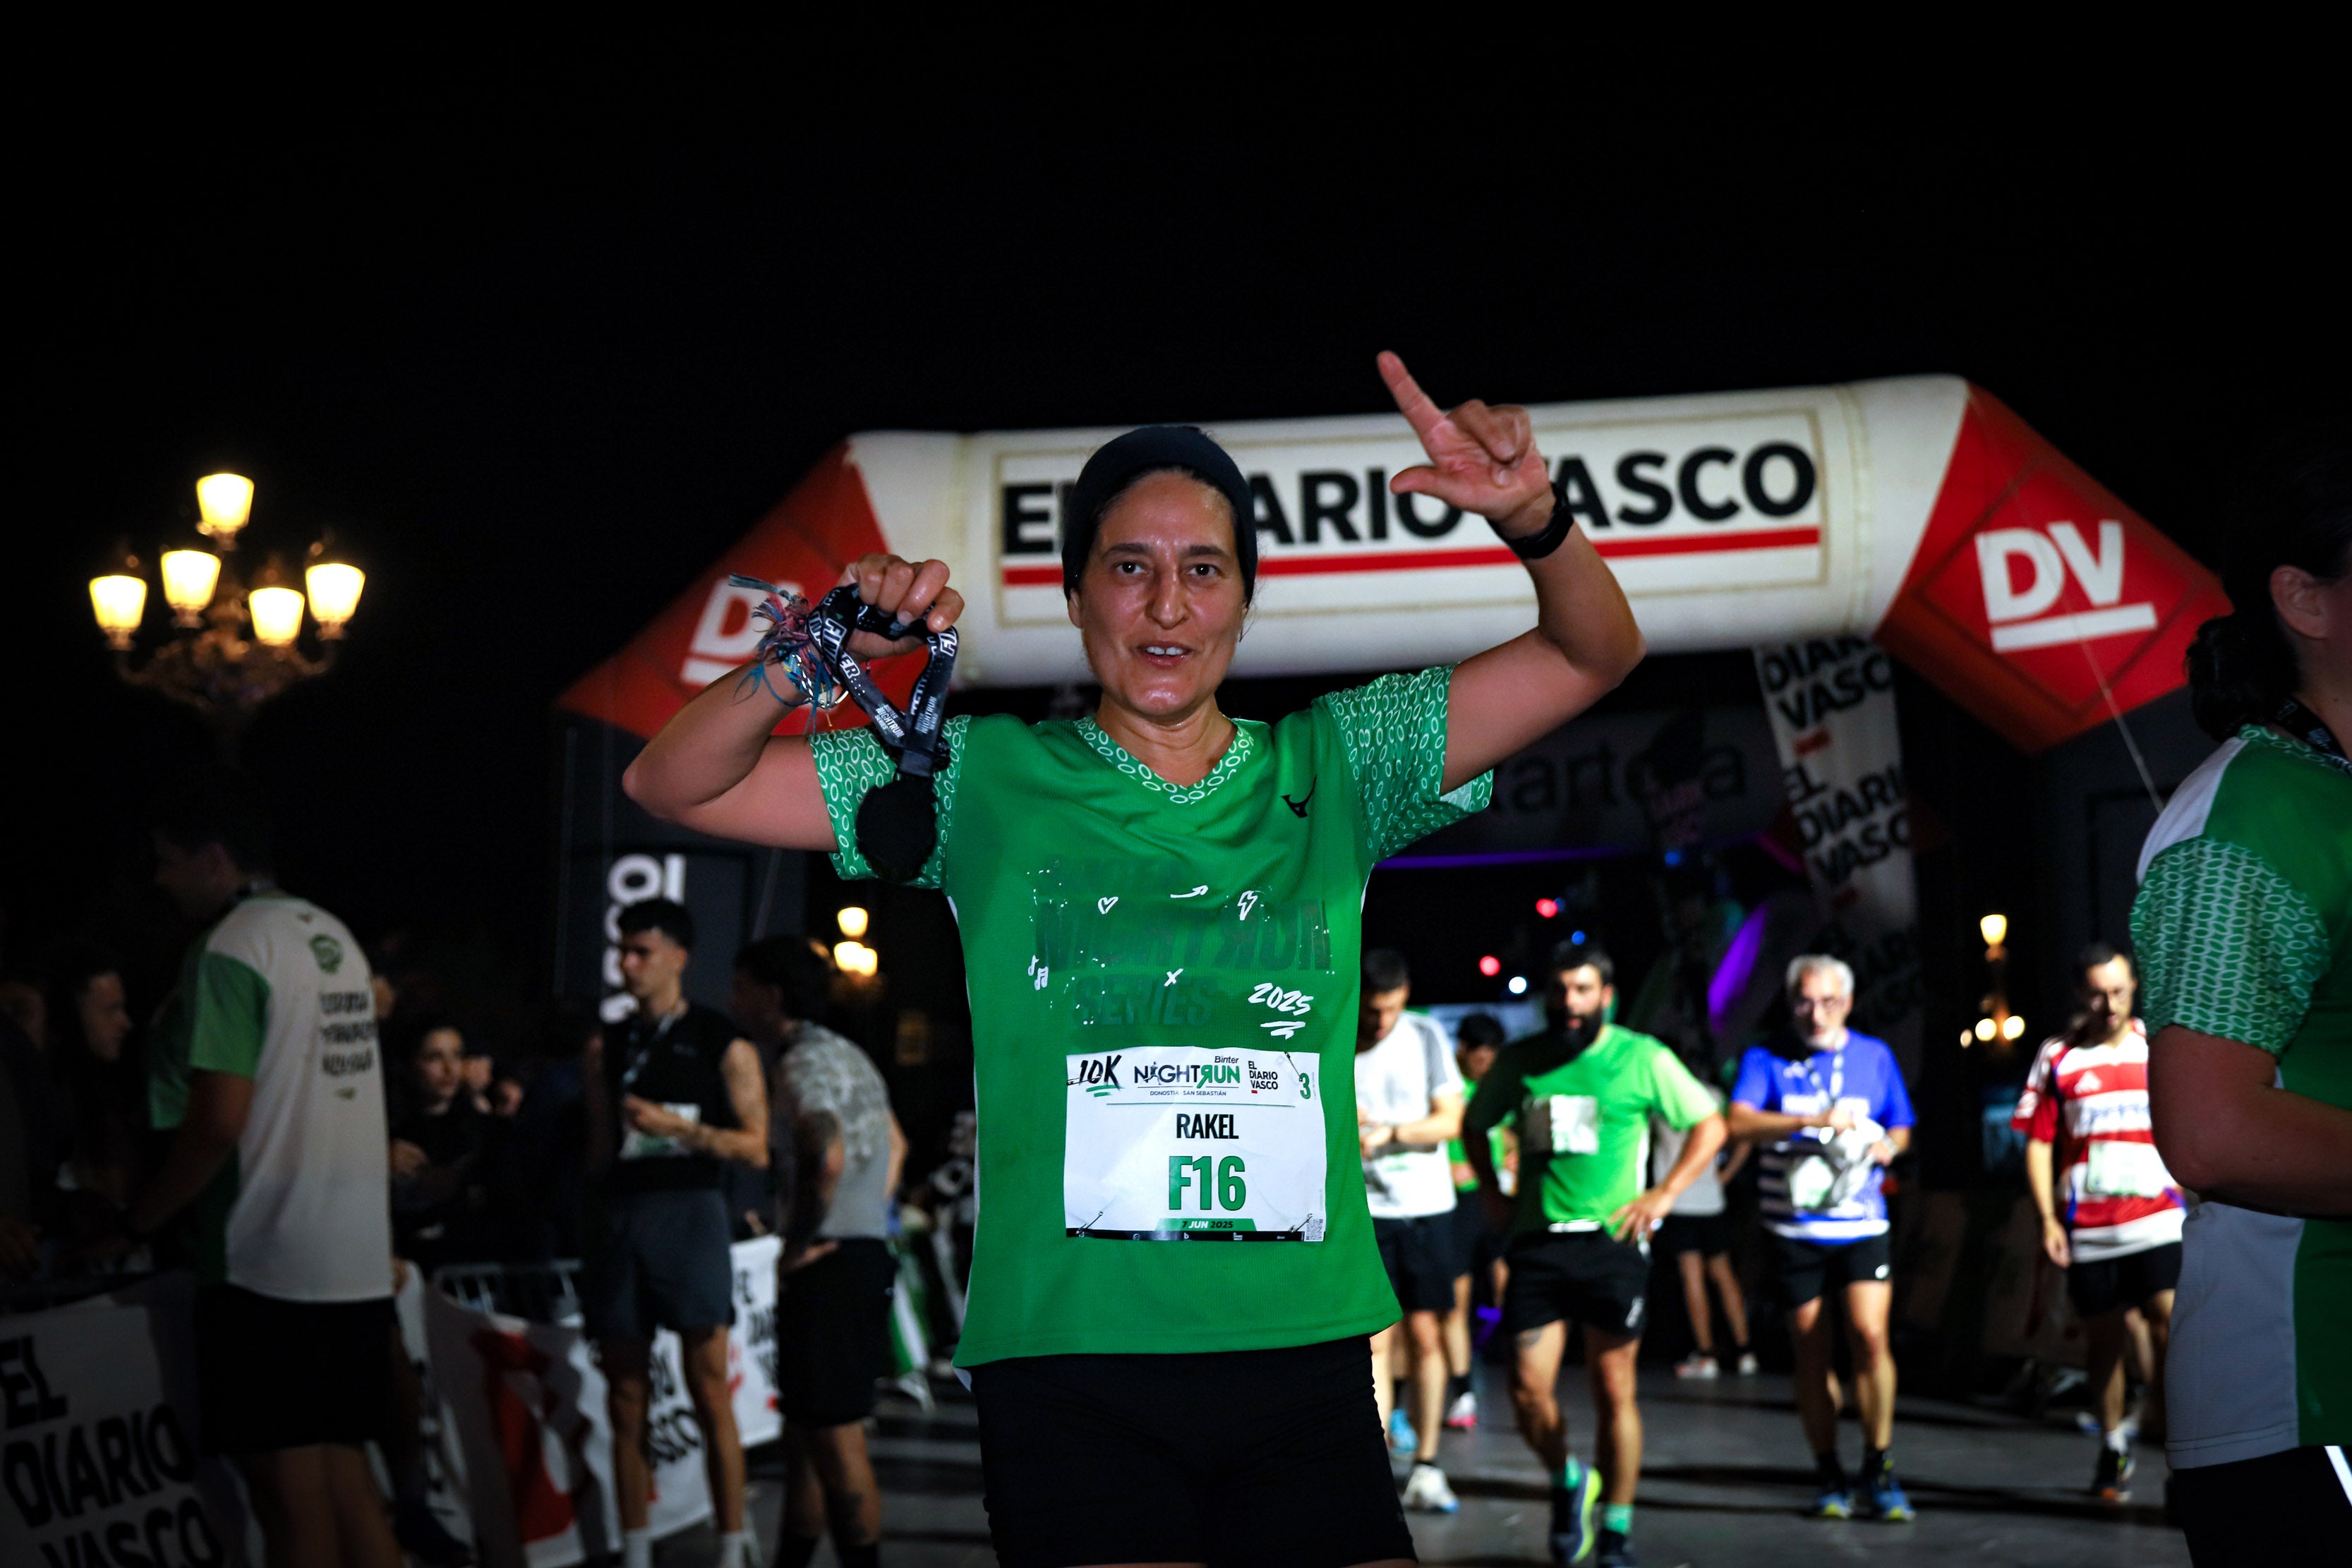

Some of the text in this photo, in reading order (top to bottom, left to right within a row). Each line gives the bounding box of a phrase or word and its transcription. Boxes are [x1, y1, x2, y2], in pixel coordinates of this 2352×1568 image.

[1003, 484, 1074, 554] E
[1545, 441, 1815, 528] ASCO
[1975, 519, 2124, 623] DV
[876, 706, 905, 738] NIGHTRUN
[1248, 982, 1315, 1016] 2025
[1079, 1054, 1123, 1090] 10K
[1214, 1055, 1239, 1064] Binter
[1248, 1061, 1257, 1069] EL
[1249, 1070, 1278, 1080] DIARIO
[1250, 1080, 1279, 1090] VASCO
[1300, 1073, 1310, 1099] 3
[1176, 1113, 1239, 1139] RAKEL
[1168, 1155, 1246, 1211] F16
[5, 1406, 195, 1528] DIARIO
